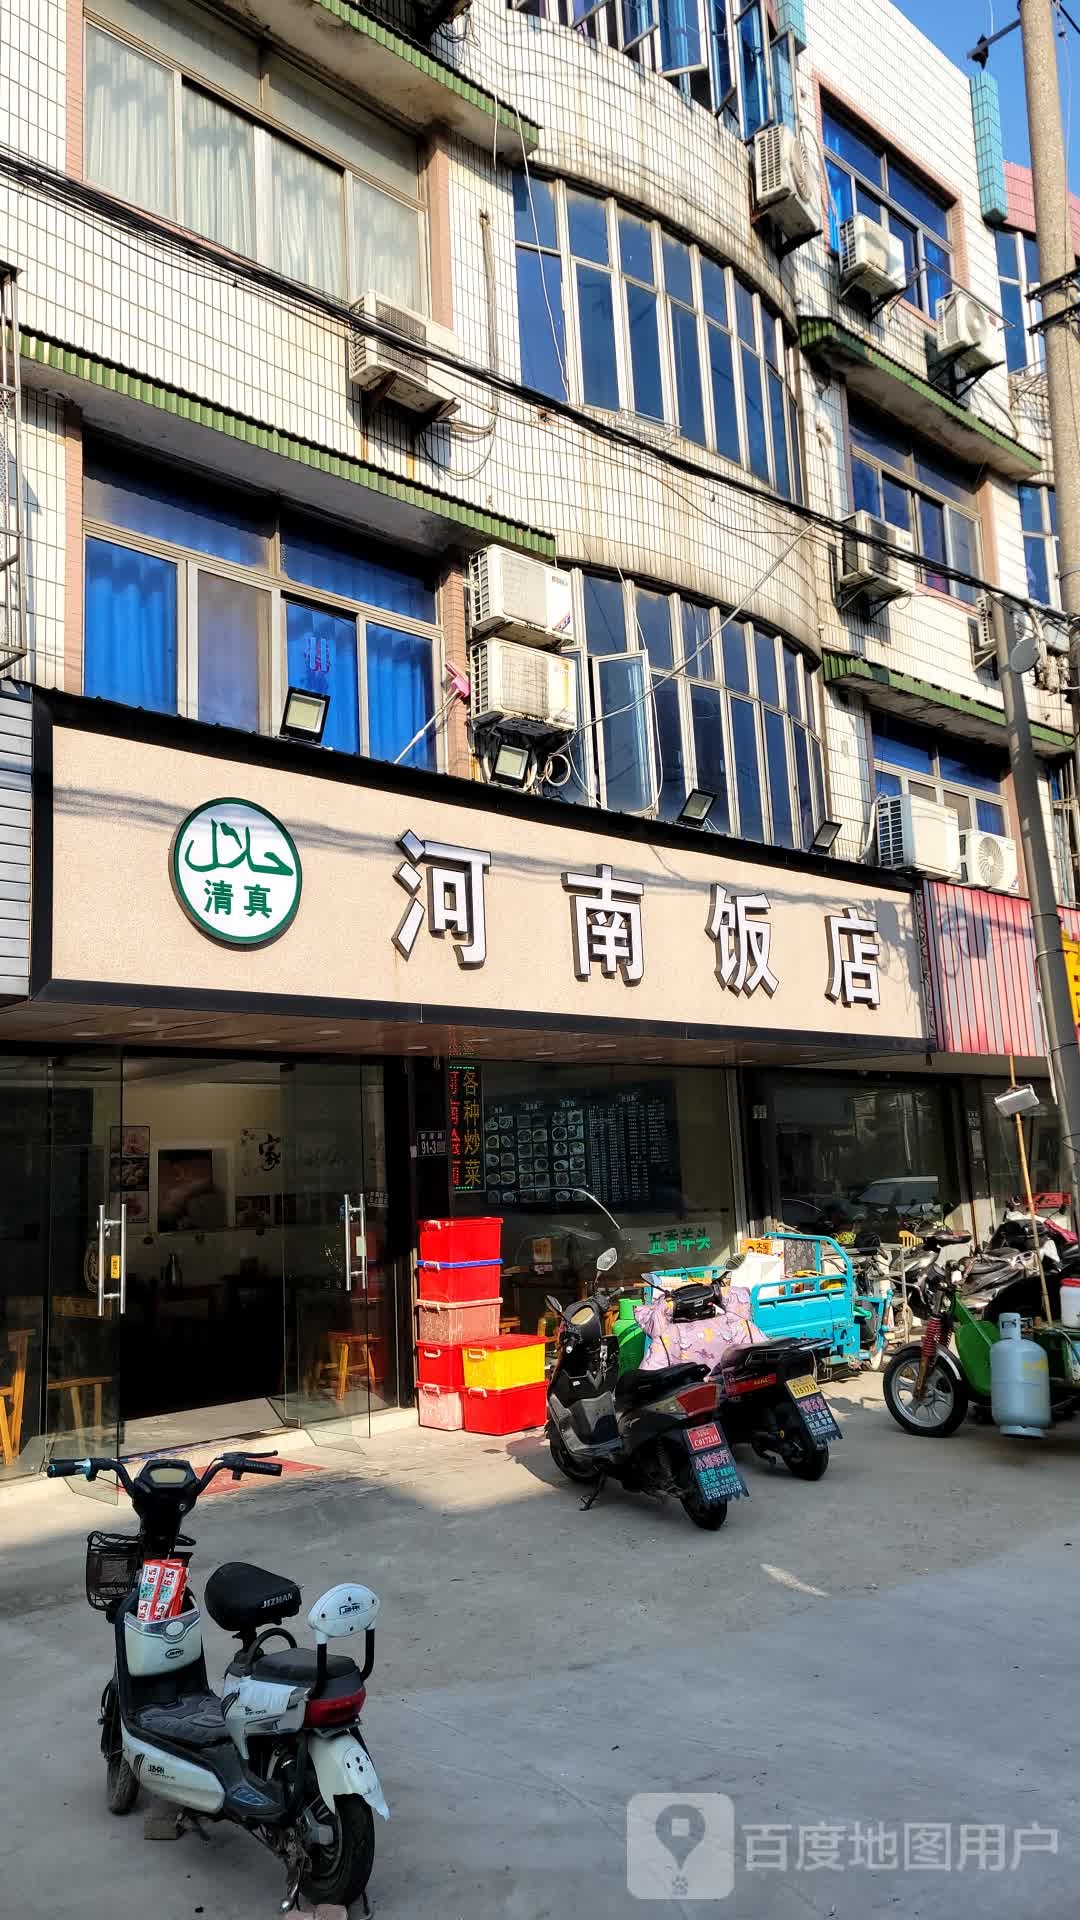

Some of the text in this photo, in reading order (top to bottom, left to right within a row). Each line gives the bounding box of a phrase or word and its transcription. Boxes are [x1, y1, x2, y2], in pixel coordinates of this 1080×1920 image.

[204, 879, 273, 918] 清真
[391, 828, 881, 1008] 河南饭店
[463, 1071, 481, 1186] 各种炒菜
